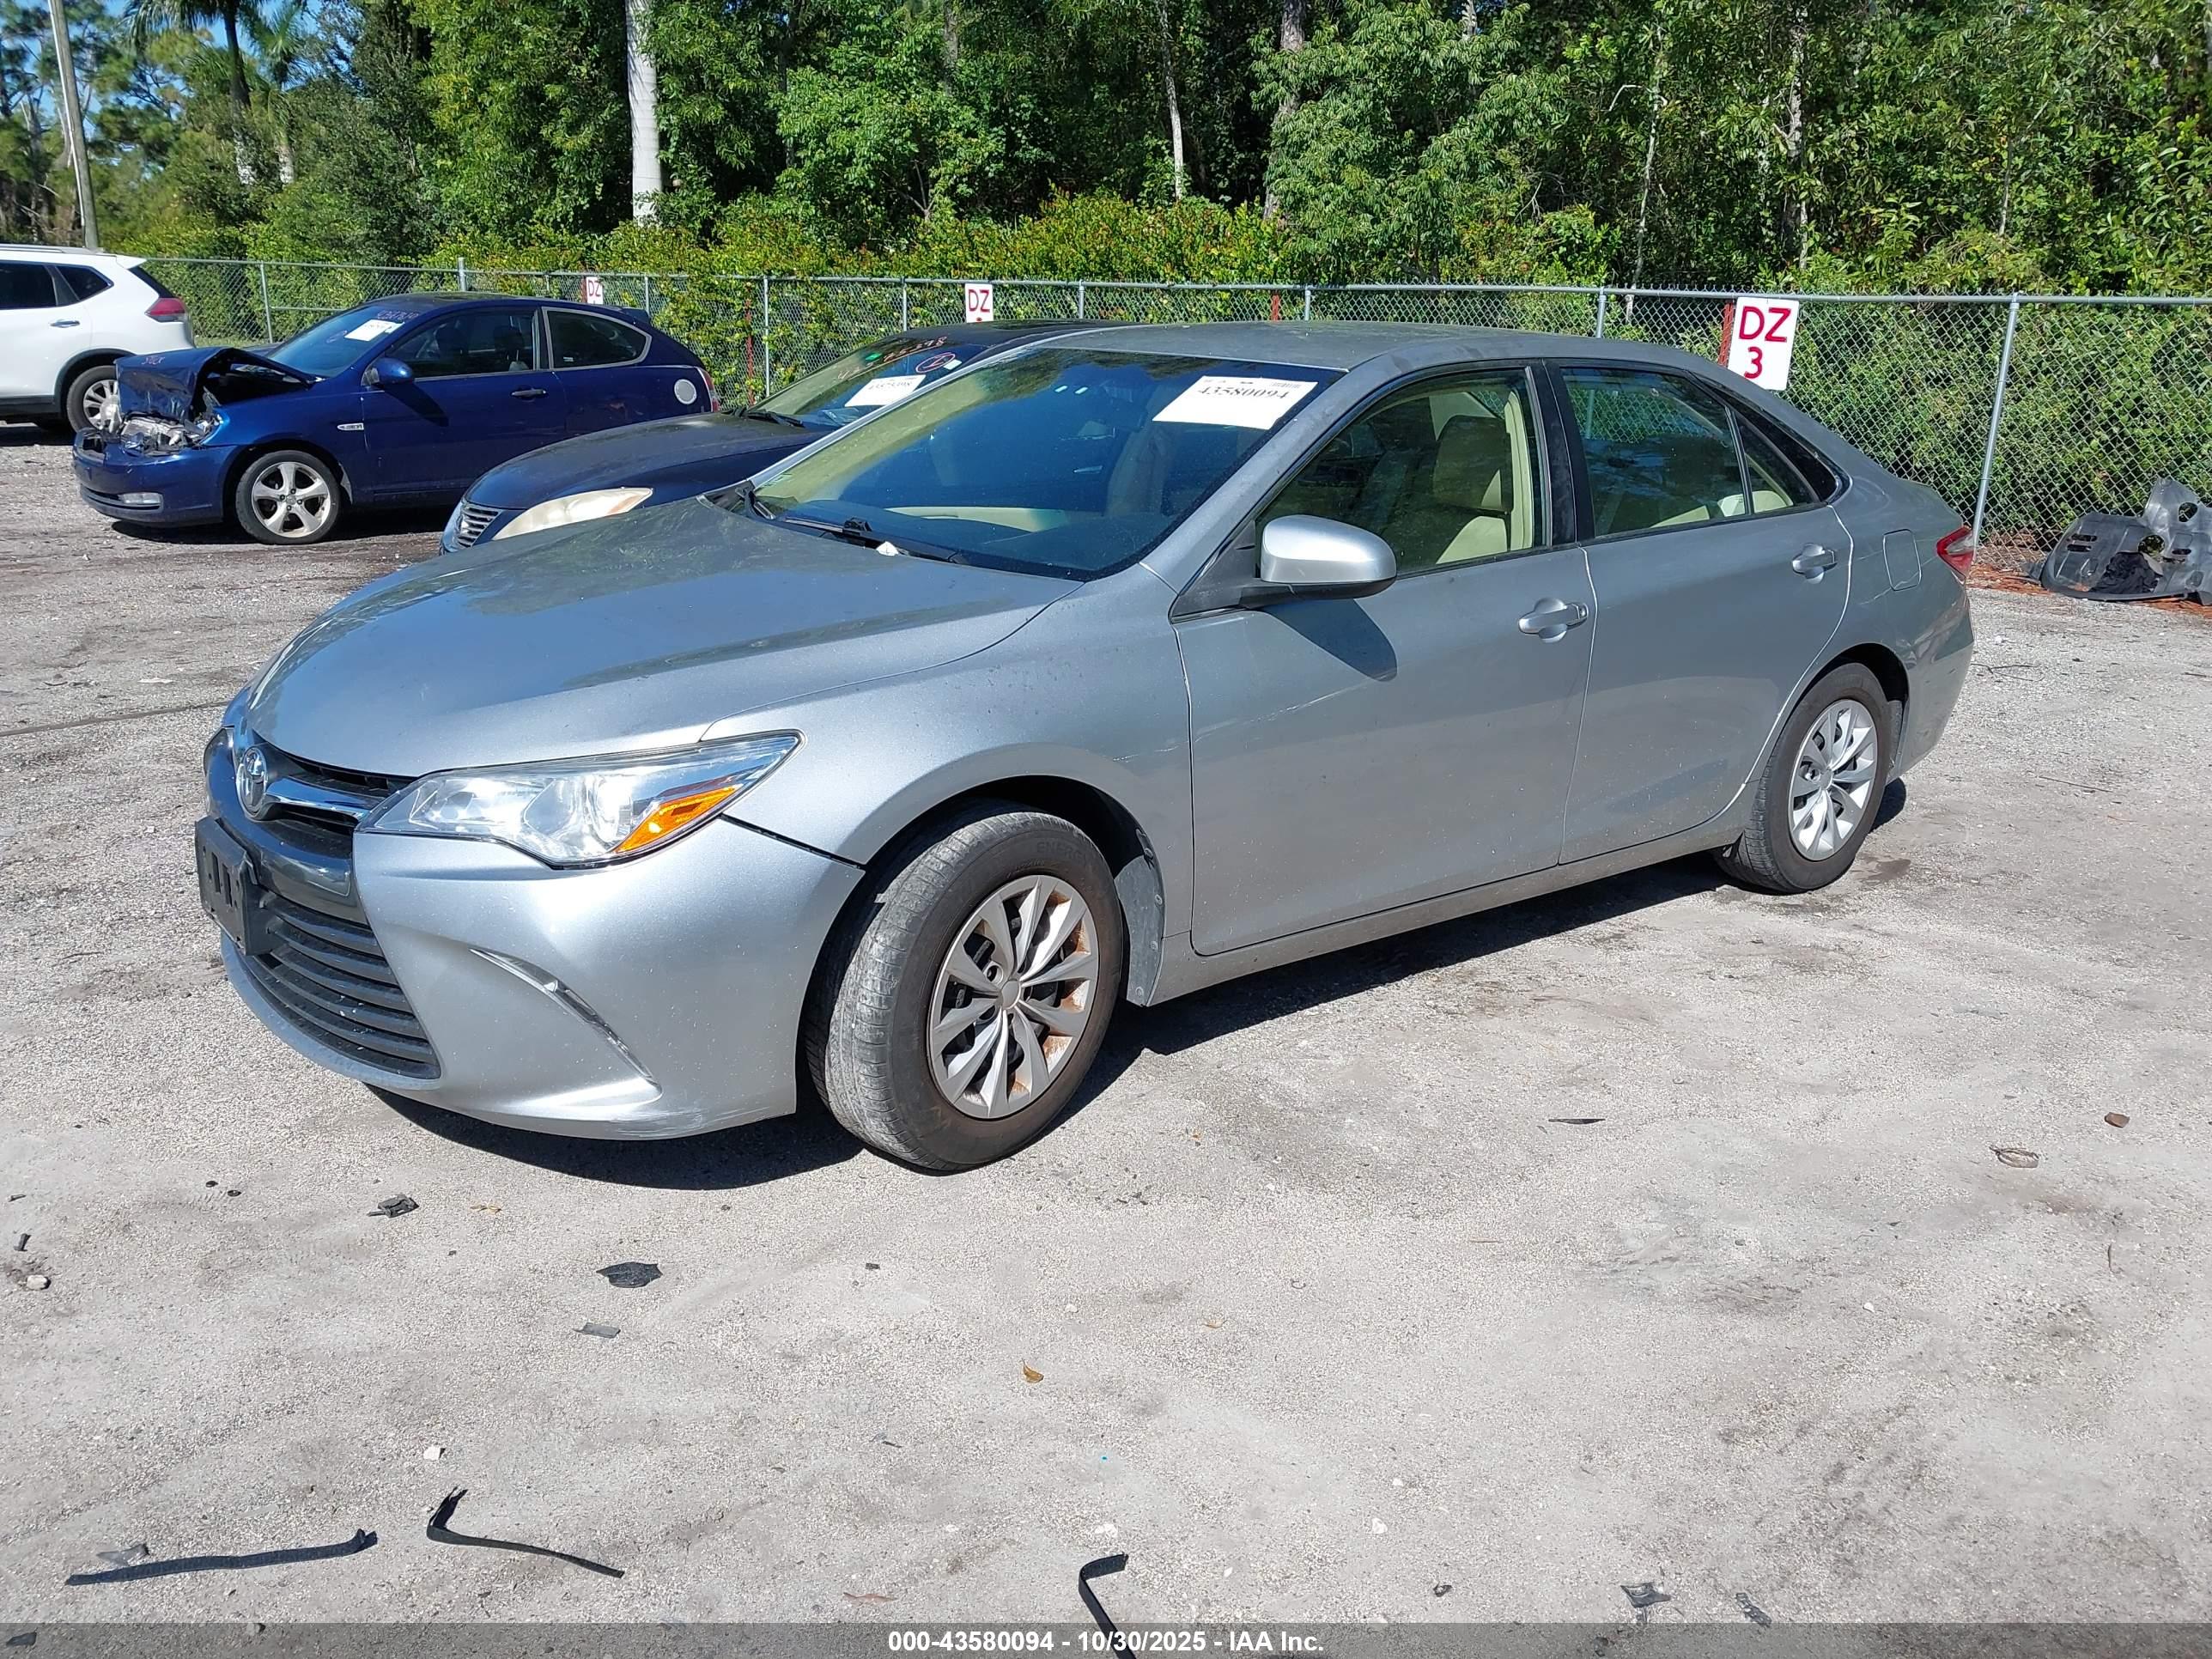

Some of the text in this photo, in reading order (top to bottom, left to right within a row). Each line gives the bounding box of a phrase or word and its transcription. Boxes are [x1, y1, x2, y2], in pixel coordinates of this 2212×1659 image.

[588, 279, 602, 297] DZ
[968, 289, 991, 313] DZ
[1739, 306, 1792, 343] DZ
[1744, 346, 1763, 380] 3
[1198, 386, 1290, 399] 43580094
